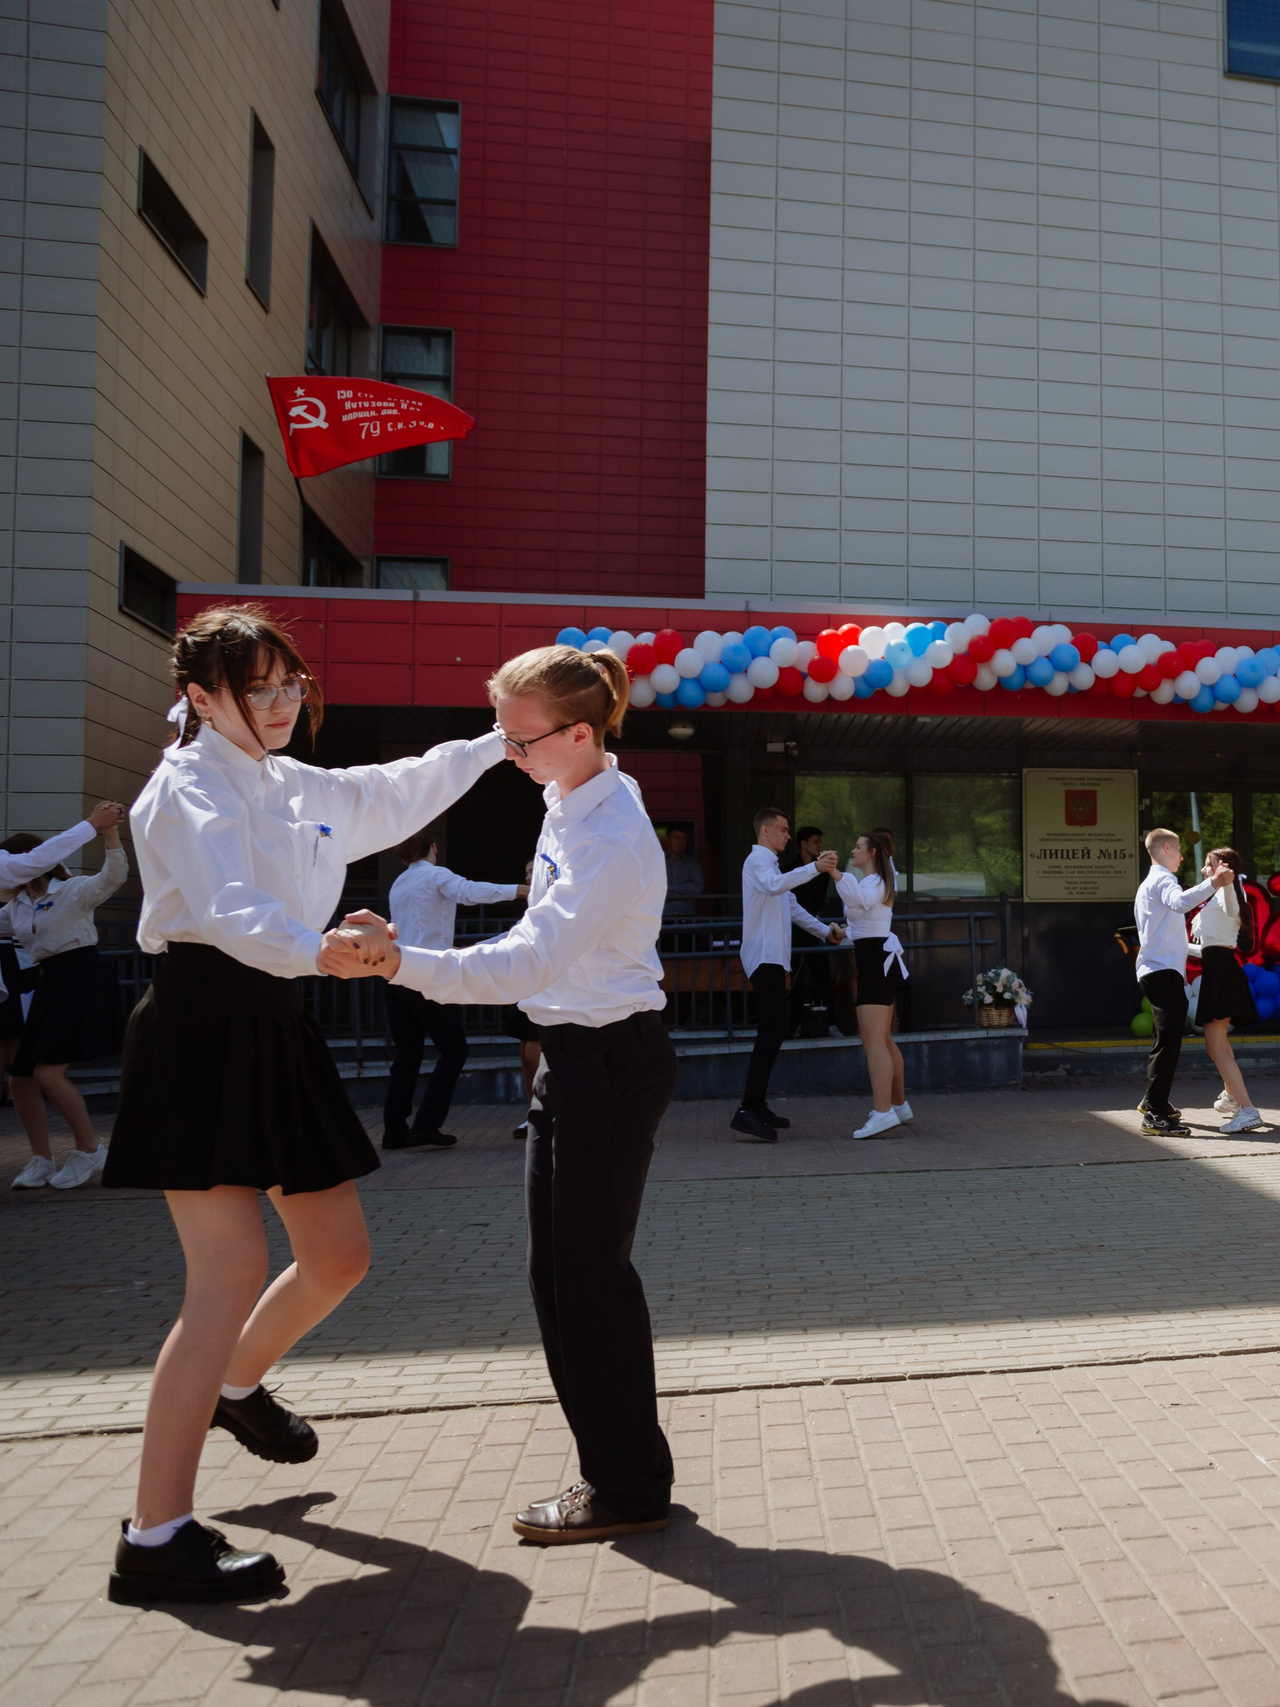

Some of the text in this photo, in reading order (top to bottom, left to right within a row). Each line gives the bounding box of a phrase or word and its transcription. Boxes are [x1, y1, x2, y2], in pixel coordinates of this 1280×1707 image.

[337, 390, 354, 399] 150
[359, 420, 380, 439] 79
[1029, 846, 1133, 862] «ЛИЦЕЙ №15»
